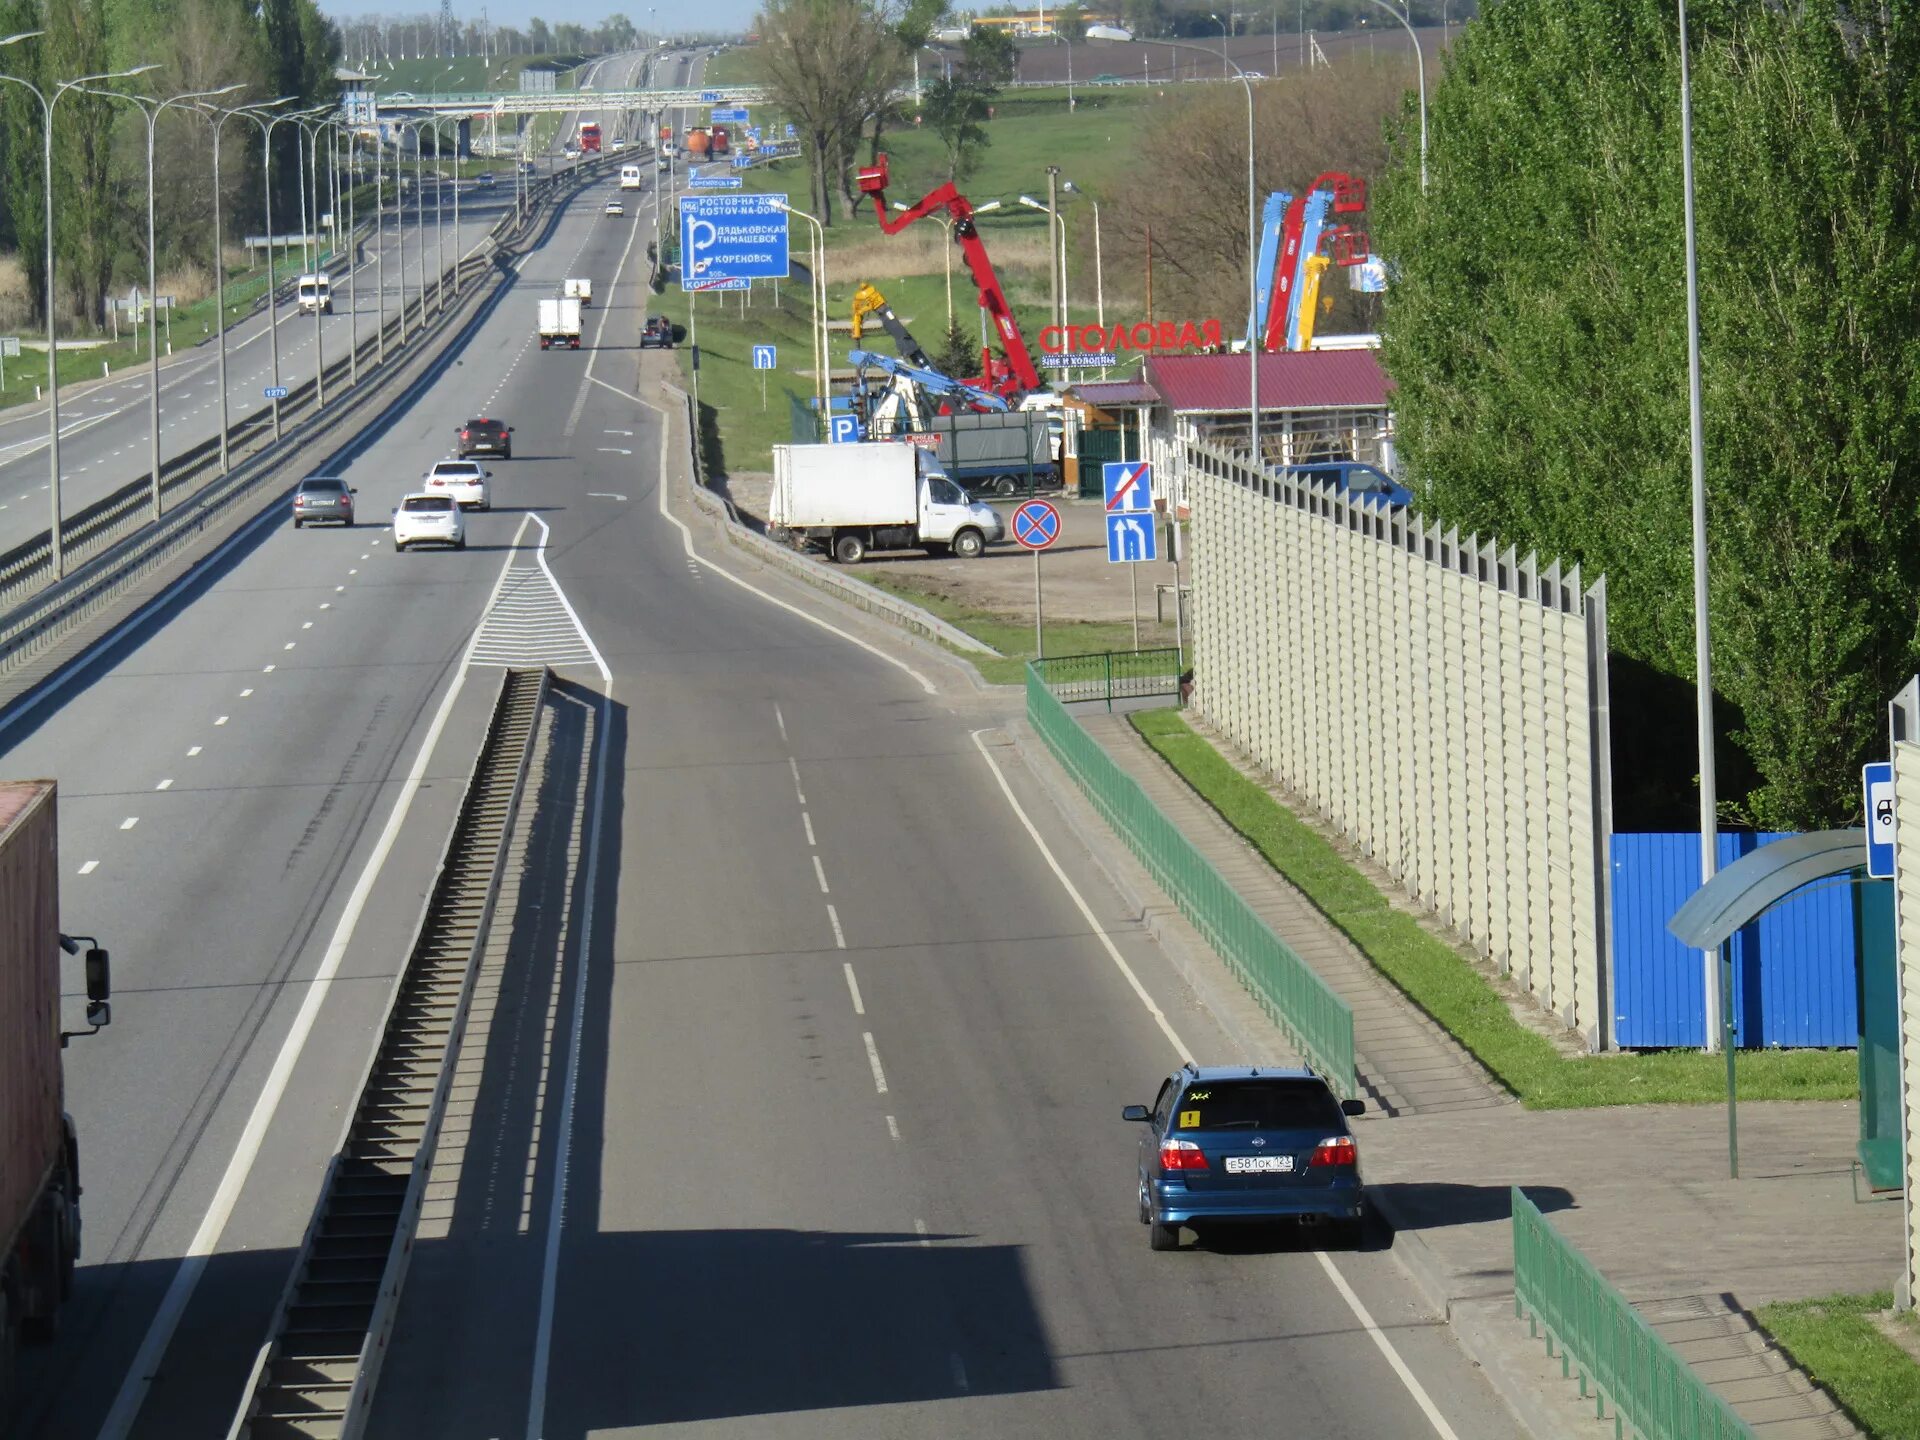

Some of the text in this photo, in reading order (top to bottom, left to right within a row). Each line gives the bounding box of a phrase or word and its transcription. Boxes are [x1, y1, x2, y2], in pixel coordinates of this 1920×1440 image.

[717, 225, 786, 236] ДЯДЬКОВСКАЯ
[717, 235, 778, 244] ТИМАШЕВСК
[715, 254, 773, 264] КОРЕНОВСК
[1038, 319, 1221, 353] СТОЛОВАЯ
[267, 389, 286, 397] 1279
[837, 419, 853, 442] P
